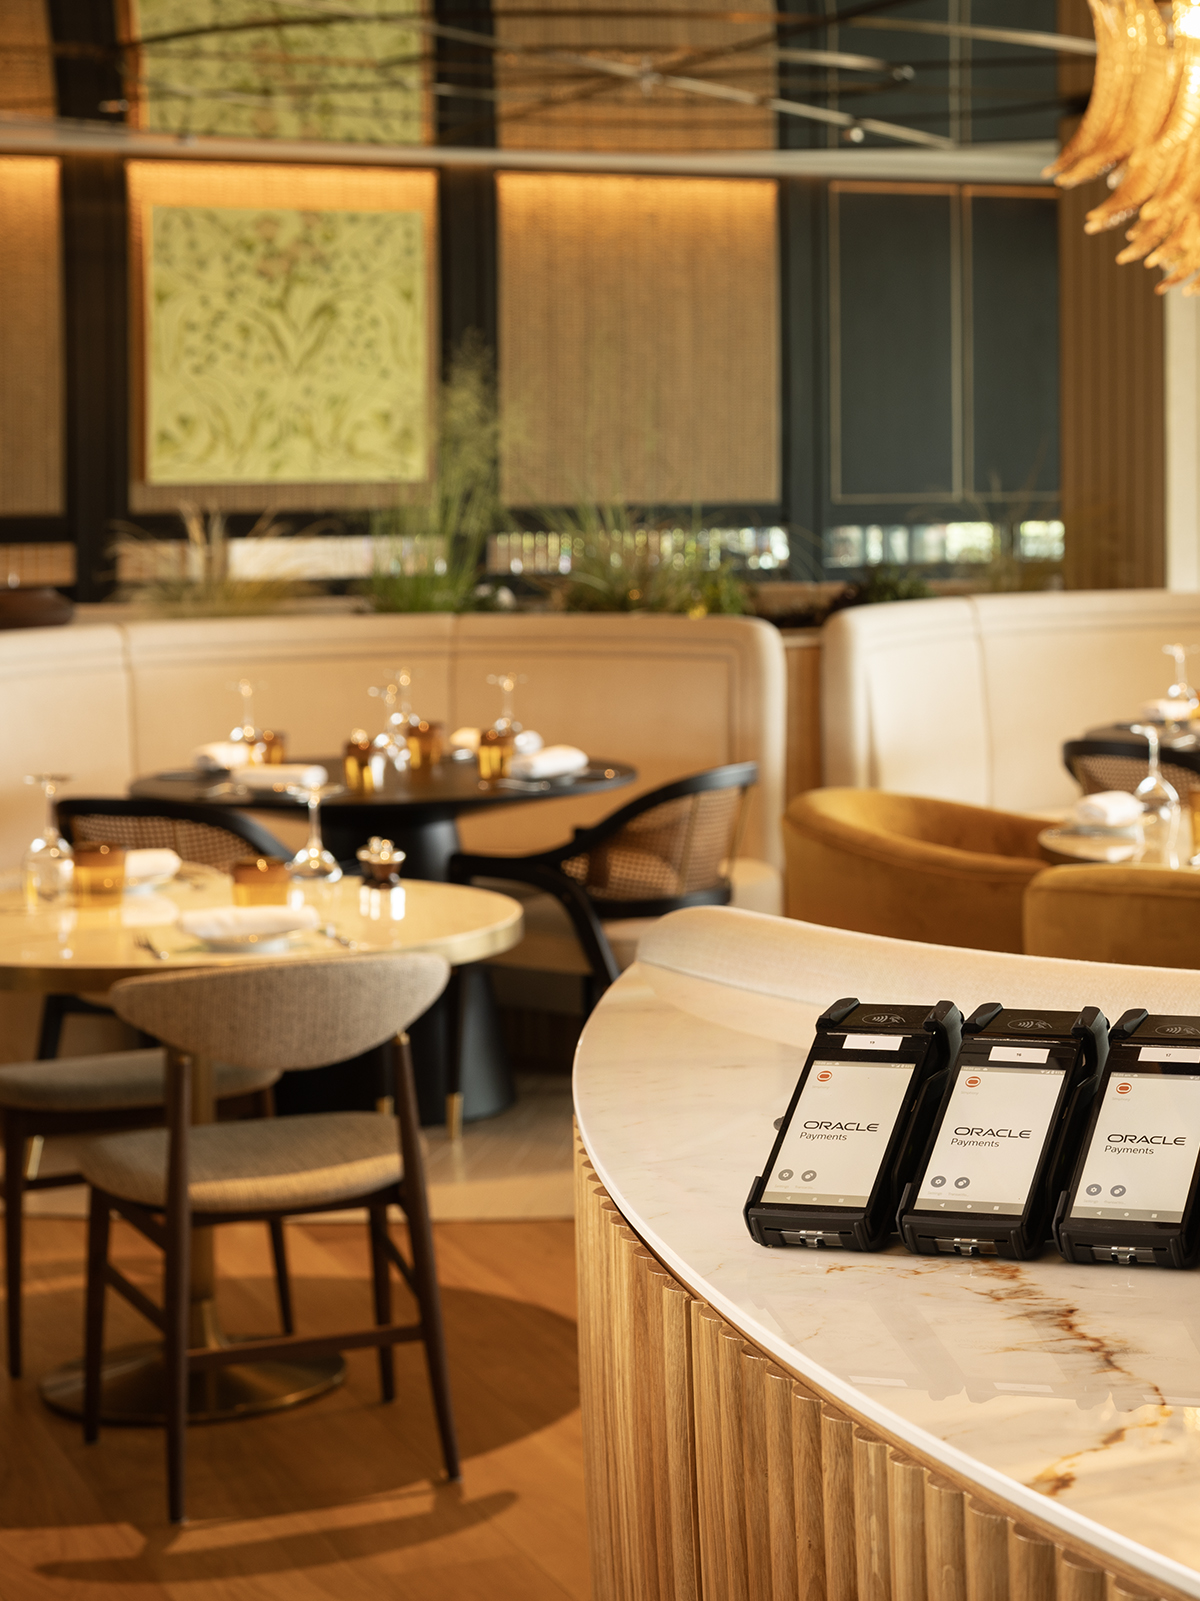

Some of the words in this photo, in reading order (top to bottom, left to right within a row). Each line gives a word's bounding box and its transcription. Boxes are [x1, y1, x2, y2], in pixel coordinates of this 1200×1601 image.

[803, 1120, 880, 1132] ORACLE
[799, 1131, 848, 1141] Payments
[954, 1126, 1032, 1139] ORACLE
[950, 1137, 1000, 1148] Payments
[1107, 1133, 1187, 1146] ORACLE
[1104, 1144, 1155, 1155] Payments
